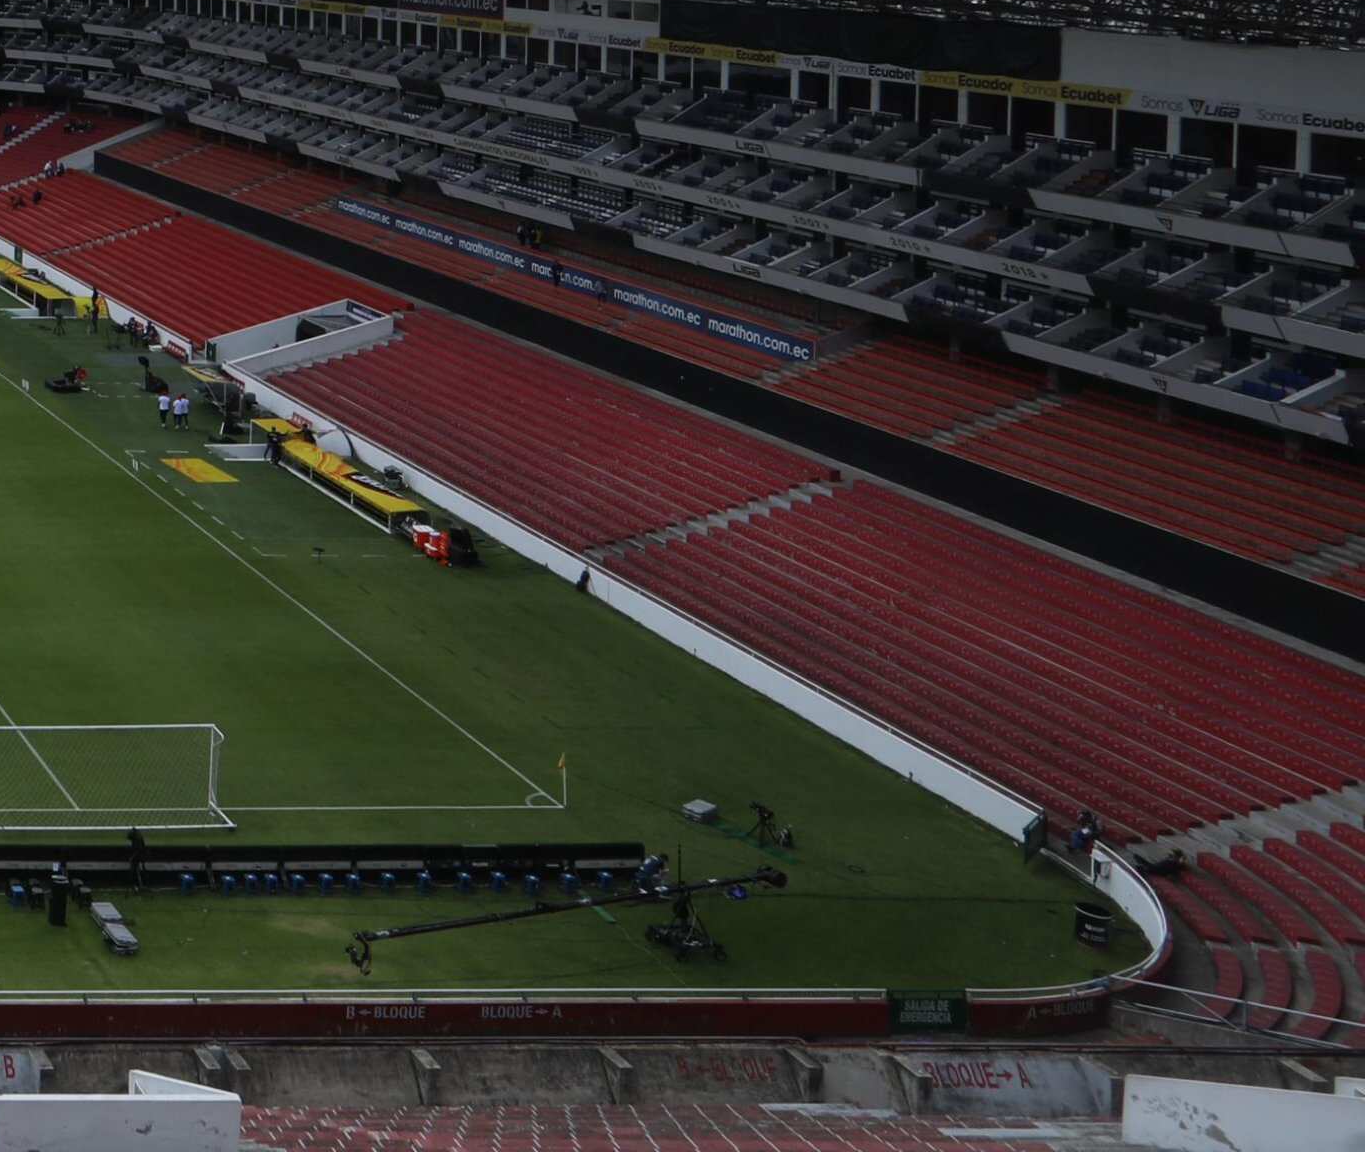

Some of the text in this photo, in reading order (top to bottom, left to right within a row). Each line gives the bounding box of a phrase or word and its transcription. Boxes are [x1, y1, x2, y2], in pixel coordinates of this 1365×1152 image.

[736, 50, 776, 64] Ecuabet
[869, 65, 916, 82] Ecuabet
[959, 74, 1013, 91] Ecuador
[1061, 86, 1122, 106] Ecuabet
[1141, 95, 1184, 113] Somos
[1257, 106, 1301, 125] Somos
[1302, 112, 1365, 133] Ecuabe
[338, 199, 390, 225] marathon.com.ec
[395, 218, 454, 246] marathon.com.ec
[459, 238, 525, 269] marathon.com.ec
[613, 287, 701, 326] marathon.com.ec
[708, 316, 810, 361] marathon.com.ec
[374, 1007, 425, 1019] BLOQUE
[482, 1006, 562, 1018] BLOQUE A
[937, 1000, 949, 1012] DE
[3, 1055, 16, 1079] B
[922, 1062, 1033, 1089] BLOQUE A
